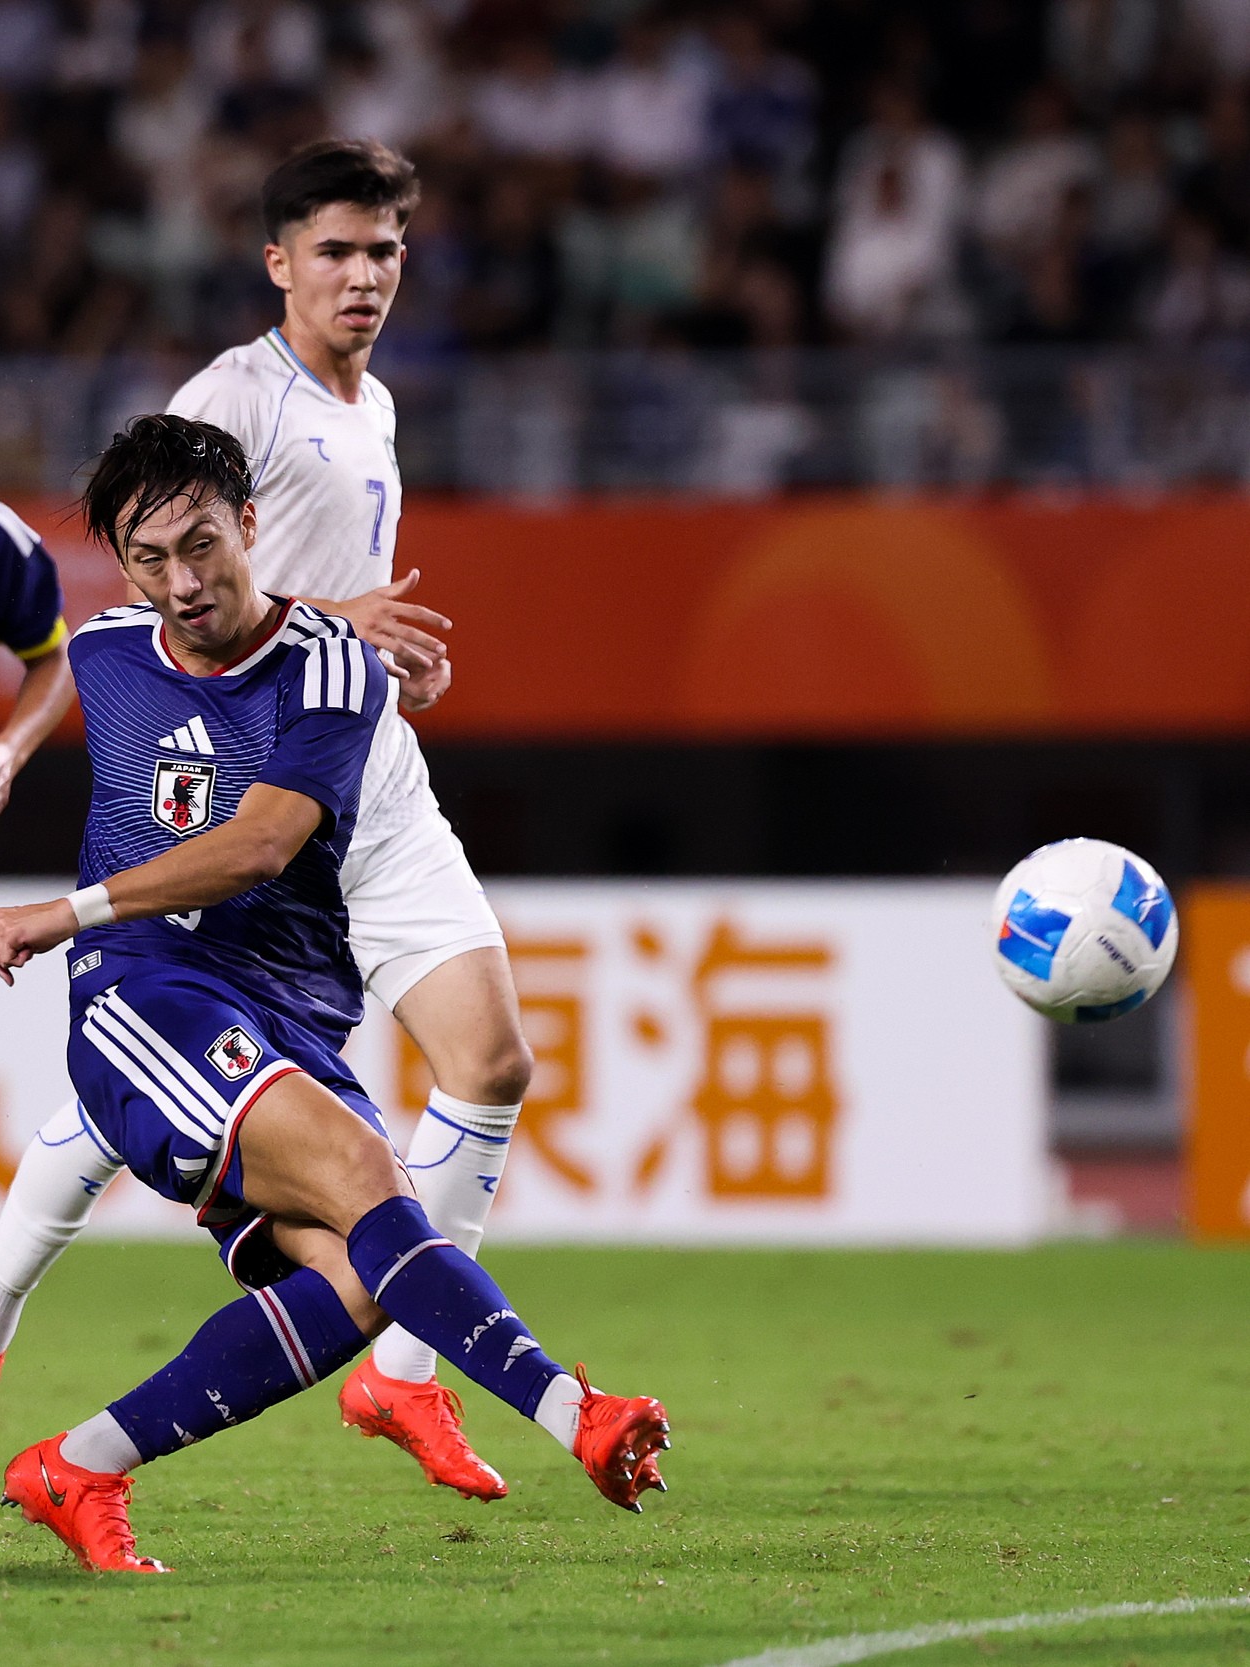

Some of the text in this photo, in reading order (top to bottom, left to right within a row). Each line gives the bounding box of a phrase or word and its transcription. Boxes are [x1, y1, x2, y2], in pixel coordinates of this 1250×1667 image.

[366, 479, 386, 556] 7
[170, 764, 202, 773] JAPAN
[168, 811, 194, 824] JFA
[213, 1030, 233, 1051] JAPAN
[206, 1388, 239, 1426] JAP
